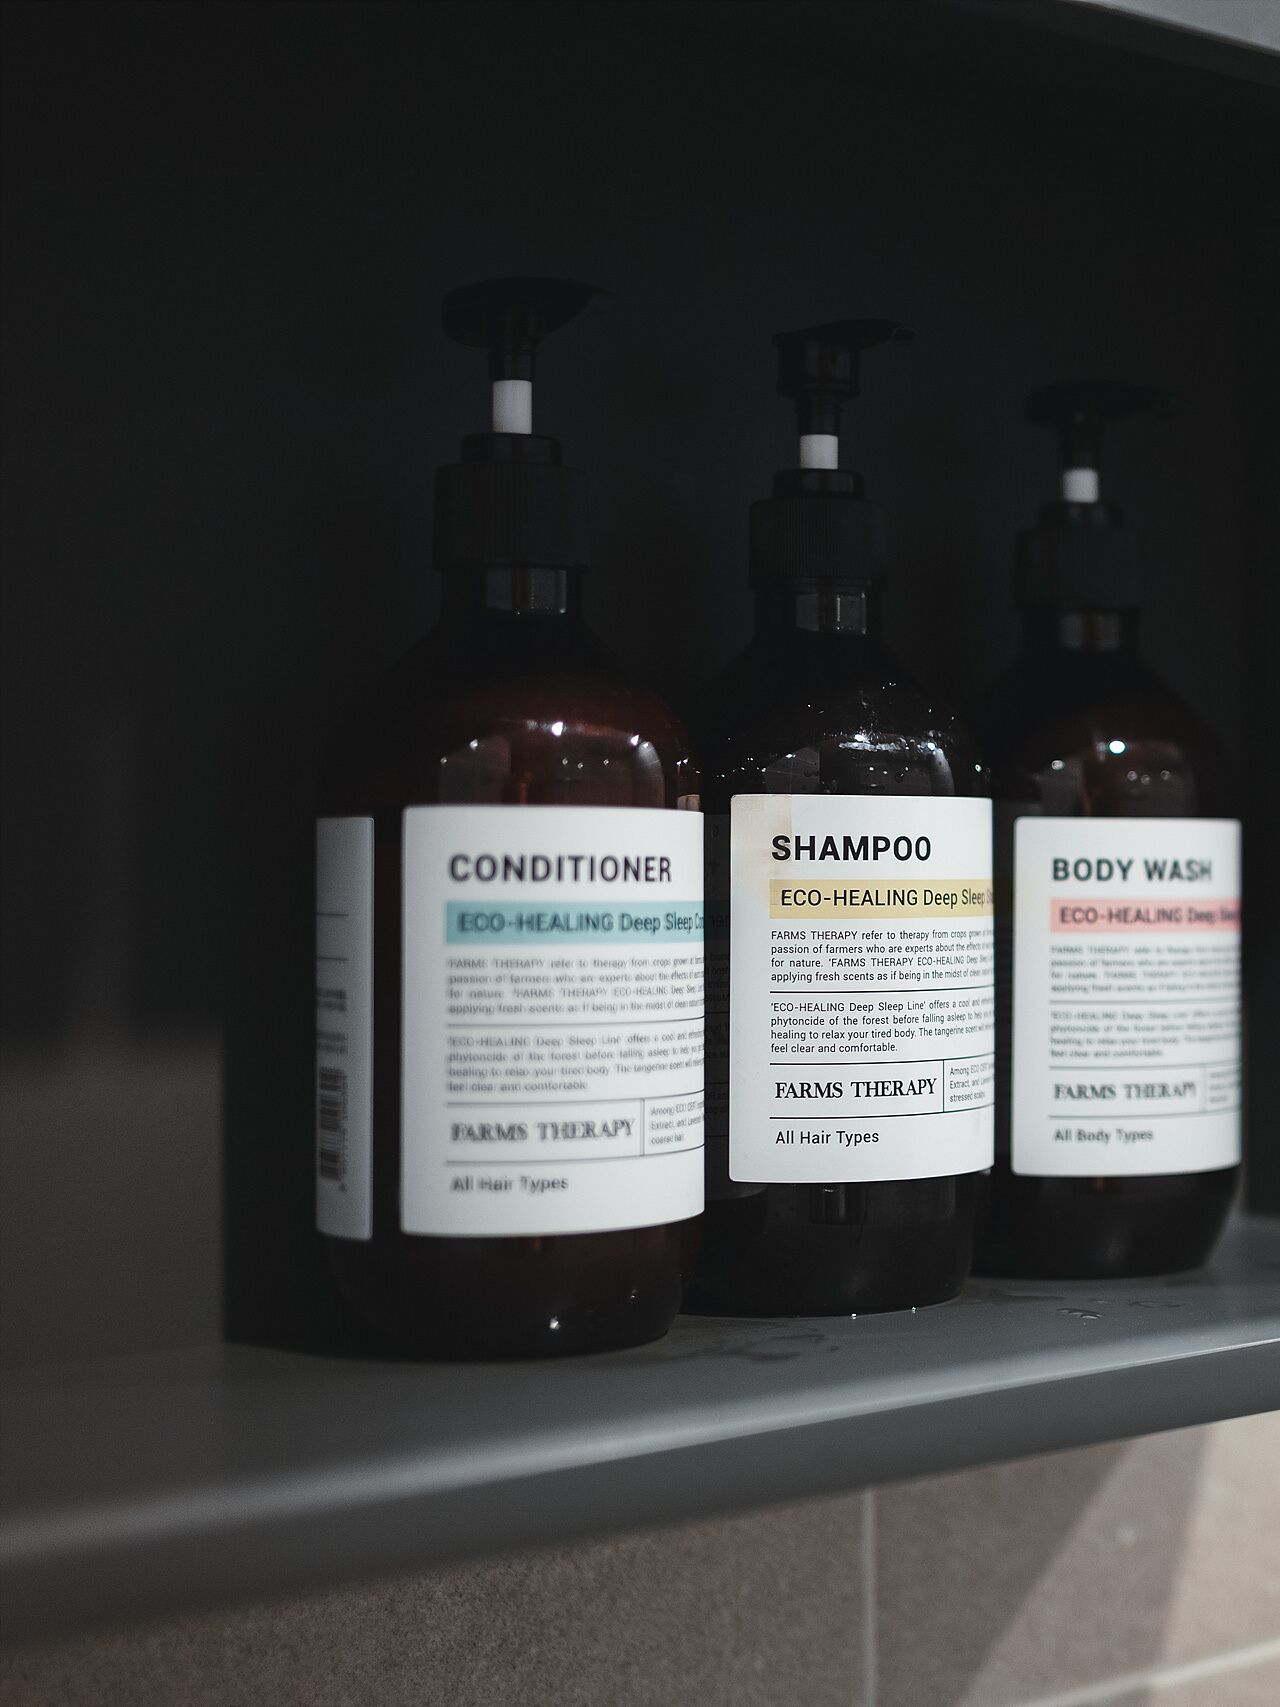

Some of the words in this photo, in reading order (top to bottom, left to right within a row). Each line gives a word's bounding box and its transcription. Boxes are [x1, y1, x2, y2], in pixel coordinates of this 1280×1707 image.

[772, 835, 931, 861] SHAMPOO
[449, 854, 672, 882] CONDITIONER
[1053, 858, 1134, 882] BODY
[1144, 859, 1212, 881] WASH
[781, 889, 918, 906] ECO-HEALING
[923, 889, 957, 909] Deep
[961, 888, 985, 908] Sleep
[457, 912, 614, 933] ECO-HEALING
[619, 913, 661, 935] Deep
[664, 912, 693, 934] Sleep
[1060, 907, 1182, 925] ECO-HEALING
[771, 931, 806, 940] FARMS
[811, 931, 857, 940] THERAPY
[862, 930, 883, 940] refer
[887, 930, 895, 939] to
[900, 930, 929, 941] therapy
[932, 929, 948, 939] from
[951, 931, 966, 941] crops
[771, 943, 809, 955] passion
[813, 943, 822, 953] of
[826, 943, 863, 953] farmers
[866, 943, 885, 953] who
[889, 945, 902, 953] are
[905, 944, 933, 955] experts
[936, 942, 954, 952] about
[956, 943, 965, 951] the
[771, 957, 784, 967] for
[789, 957, 823, 967] nature.
[871, 957, 913, 967] THERAPY
[917, 956, 964, 966] ECO-HEALING
[771, 971, 812, 983] applying
[815, 970, 840, 981] fresh
[843, 970, 874, 980] scents
[877, 972, 888, 980] as
[890, 970, 896, 980] if
[899, 970, 921, 982] being
[923, 970, 930, 979] in
[932, 970, 943, 979] the
[945, 969, 962, 979] midst
[963, 968, 968, 978] of
[849, 1003, 874, 1014] Deep
[878, 1002, 903, 1013] Sleep
[929, 999, 949, 1009] offers
[959, 999, 970, 1007] cool
[771, 1016, 825, 1028] phytoncide
[829, 1015, 838, 1025] of
[843, 1016, 858, 1025] the
[862, 1015, 889, 1025] forest
[893, 1014, 919, 1025] before
[922, 1013, 944, 1025] falling
[947, 1012, 966, 1023] asleep
[968, 1012, 973, 1020] to
[771, 1030, 806, 1042] healing
[809, 1030, 819, 1039] to
[821, 1029, 845, 1039] relax
[848, 1031, 869, 1041] your
[871, 1028, 891, 1039] tired
[894, 1028, 916, 1040] body.
[919, 1028, 932, 1037] The
[935, 1026, 964, 1038] tangerine
[965, 1025, 978, 1034] scent
[771, 1043, 788, 1053] feel
[791, 1043, 814, 1053] clear
[818, 1043, 836, 1053] and
[839, 1042, 898, 1053] comfortable.
[950, 1067, 969, 1076] Among
[971, 1065, 979, 1074] ECO
[775, 1082, 843, 1099] FARMS
[851, 1078, 937, 1098] THERAPY
[950, 1092, 974, 1102] stressed
[1054, 1083, 1116, 1100] FARMS
[1123, 1081, 1196, 1099] THERAPY
[451, 1122, 529, 1142] FARMS
[537, 1117, 636, 1141] THERAPY
[1055, 1128, 1072, 1142] All
[1077, 1128, 1110, 1144] Body
[1116, 1128, 1153, 1145] Types
[776, 1131, 794, 1144] All
[801, 1131, 831, 1144] Hair
[836, 1132, 880, 1147] Types
[453, 1176, 473, 1191] All
[480, 1176, 514, 1191] Hair
[520, 1174, 569, 1193] Types
